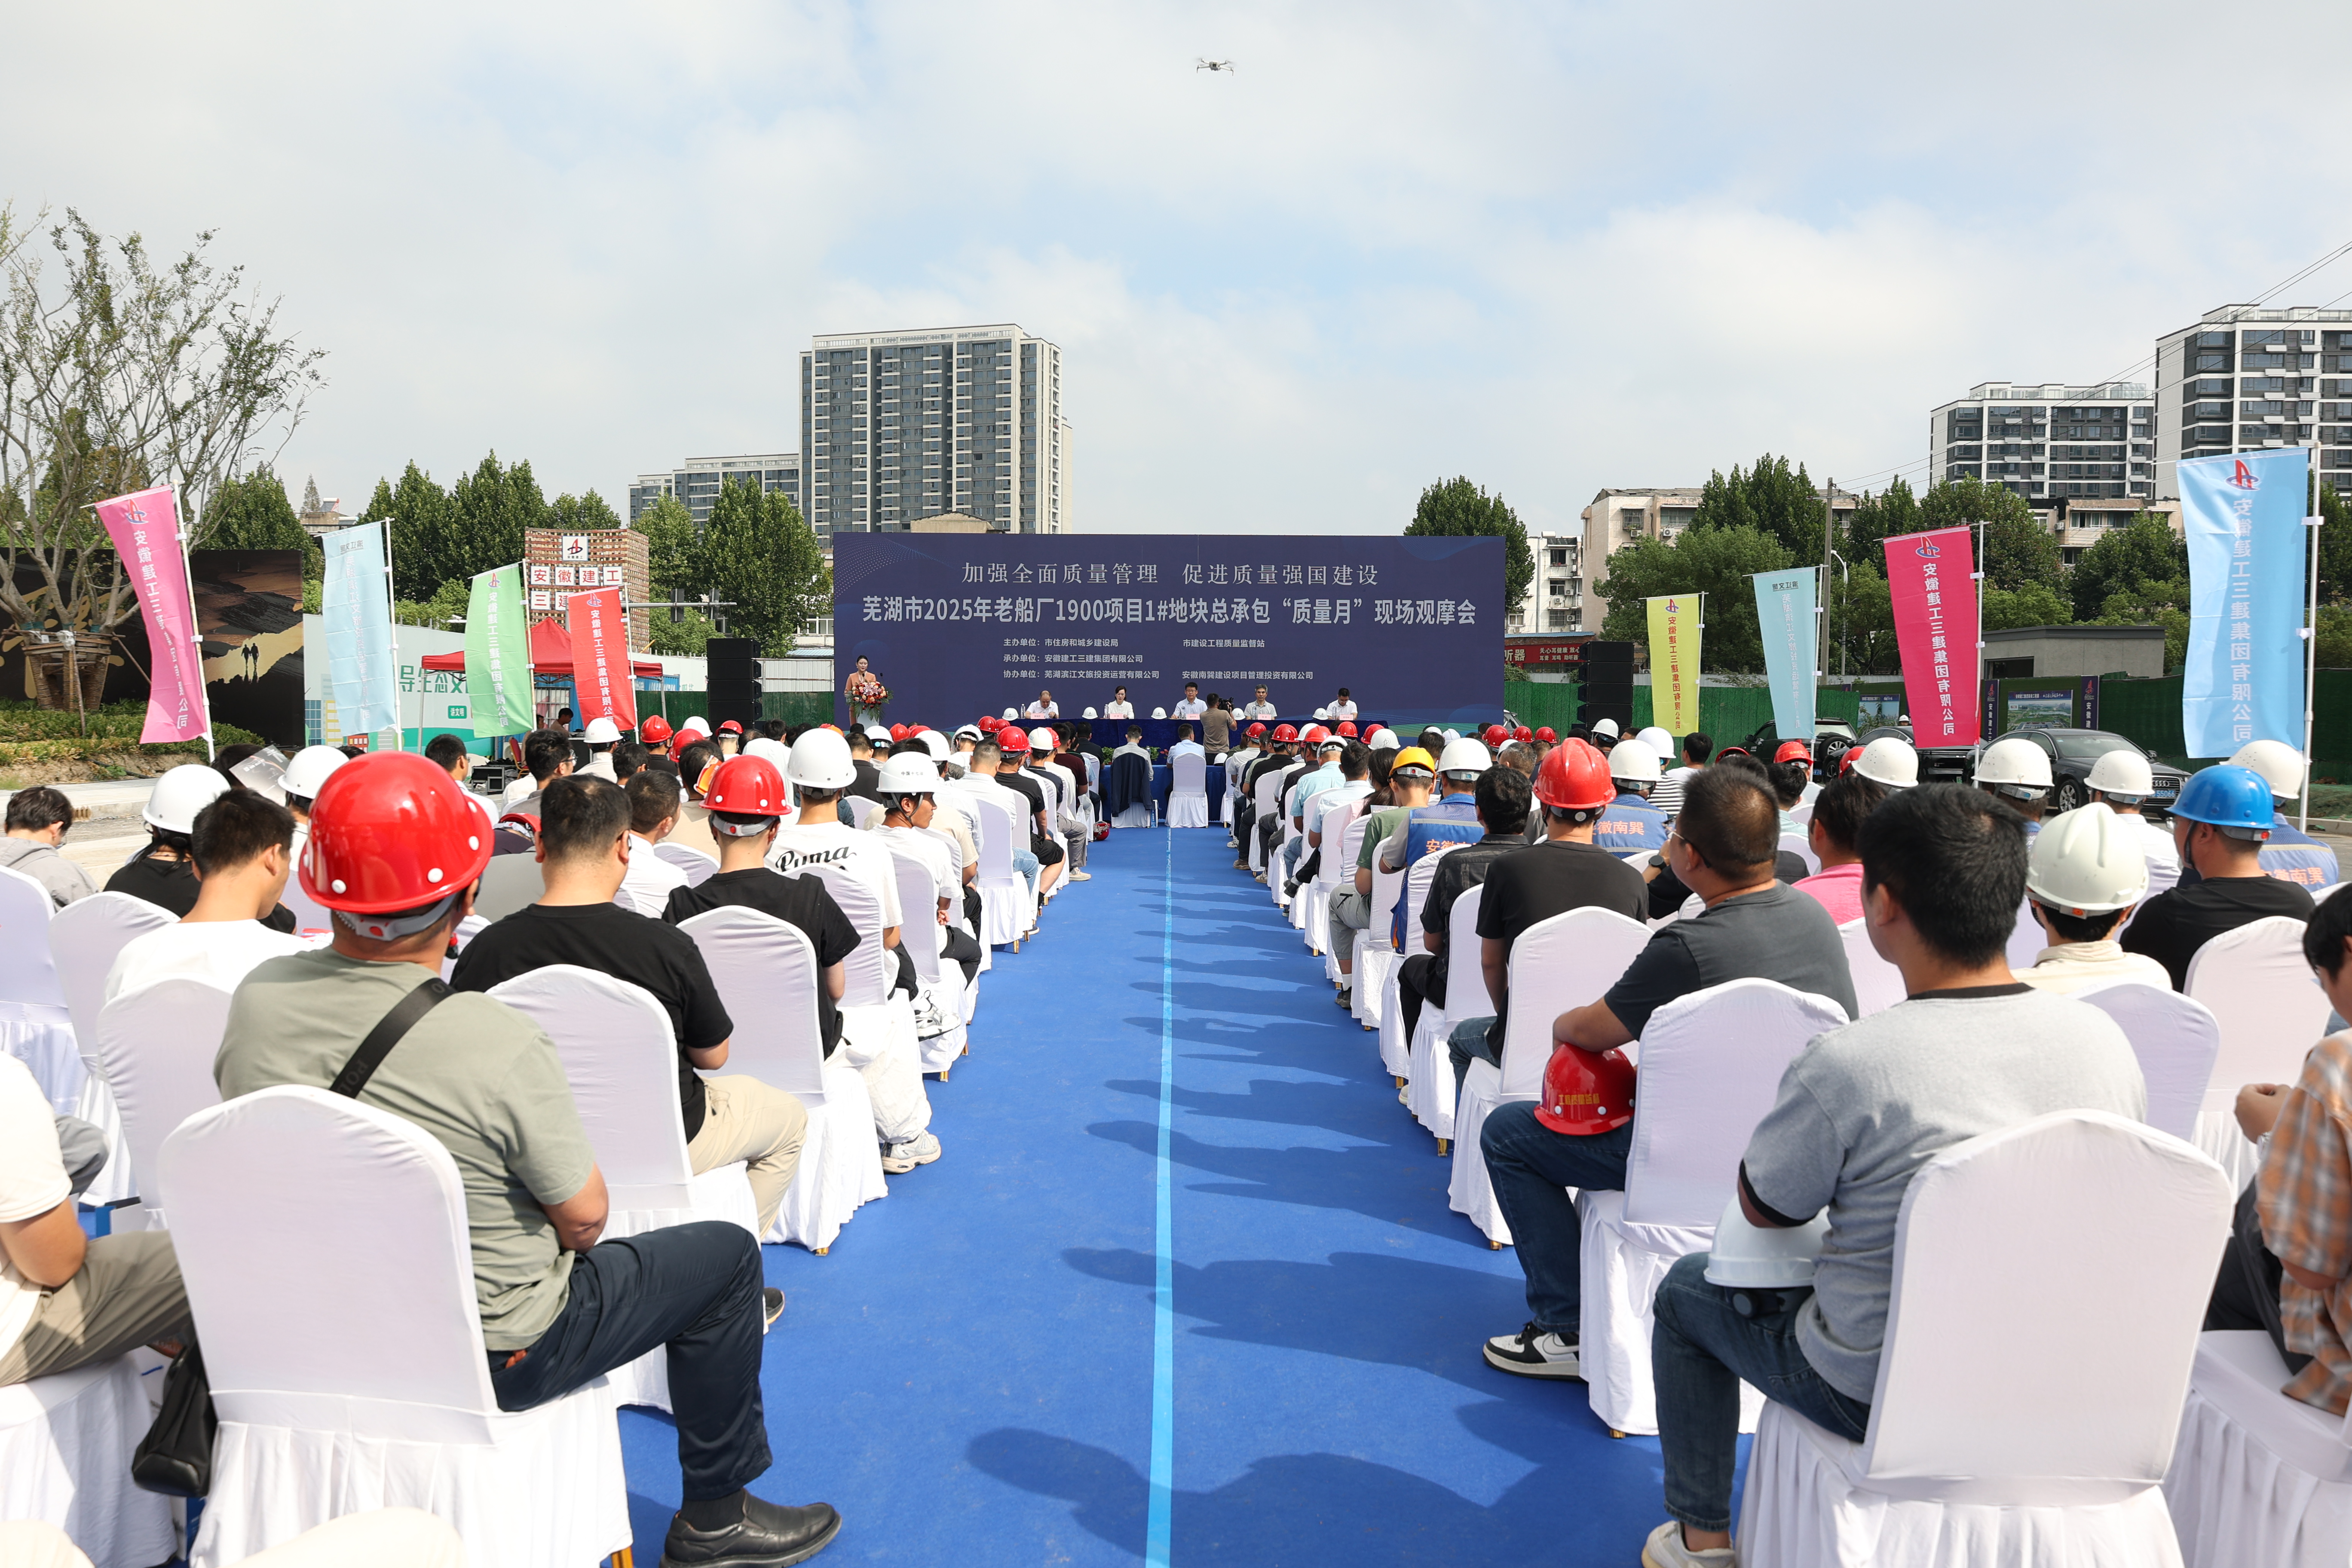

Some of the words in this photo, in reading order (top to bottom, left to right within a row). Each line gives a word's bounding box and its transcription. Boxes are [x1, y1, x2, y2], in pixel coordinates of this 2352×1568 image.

[534, 569, 620, 583] 安徽建工
[962, 562, 1158, 585] 加强全面质量管理
[1182, 563, 1378, 586] 促进质量强国建设
[1003, 638, 1118, 647] 主办单位：市住房和城乡建设局
[1182, 639, 1265, 648] 市建设工程质量监督站
[1003, 654, 1143, 663] 承办单位：安徽建工三建集团有限公司
[399, 665, 469, 693] 导生态文
[1003, 671, 1160, 679] 协办单位：芜湖滨江文旅投资运营有限公司
[1182, 671, 1313, 680] 安徽南巽建设项目管理投资有限公司
[1425, 839, 1477, 854] 安徽
[775, 846, 857, 872] Puma
[2261, 867, 2326, 885] 徽南巽
